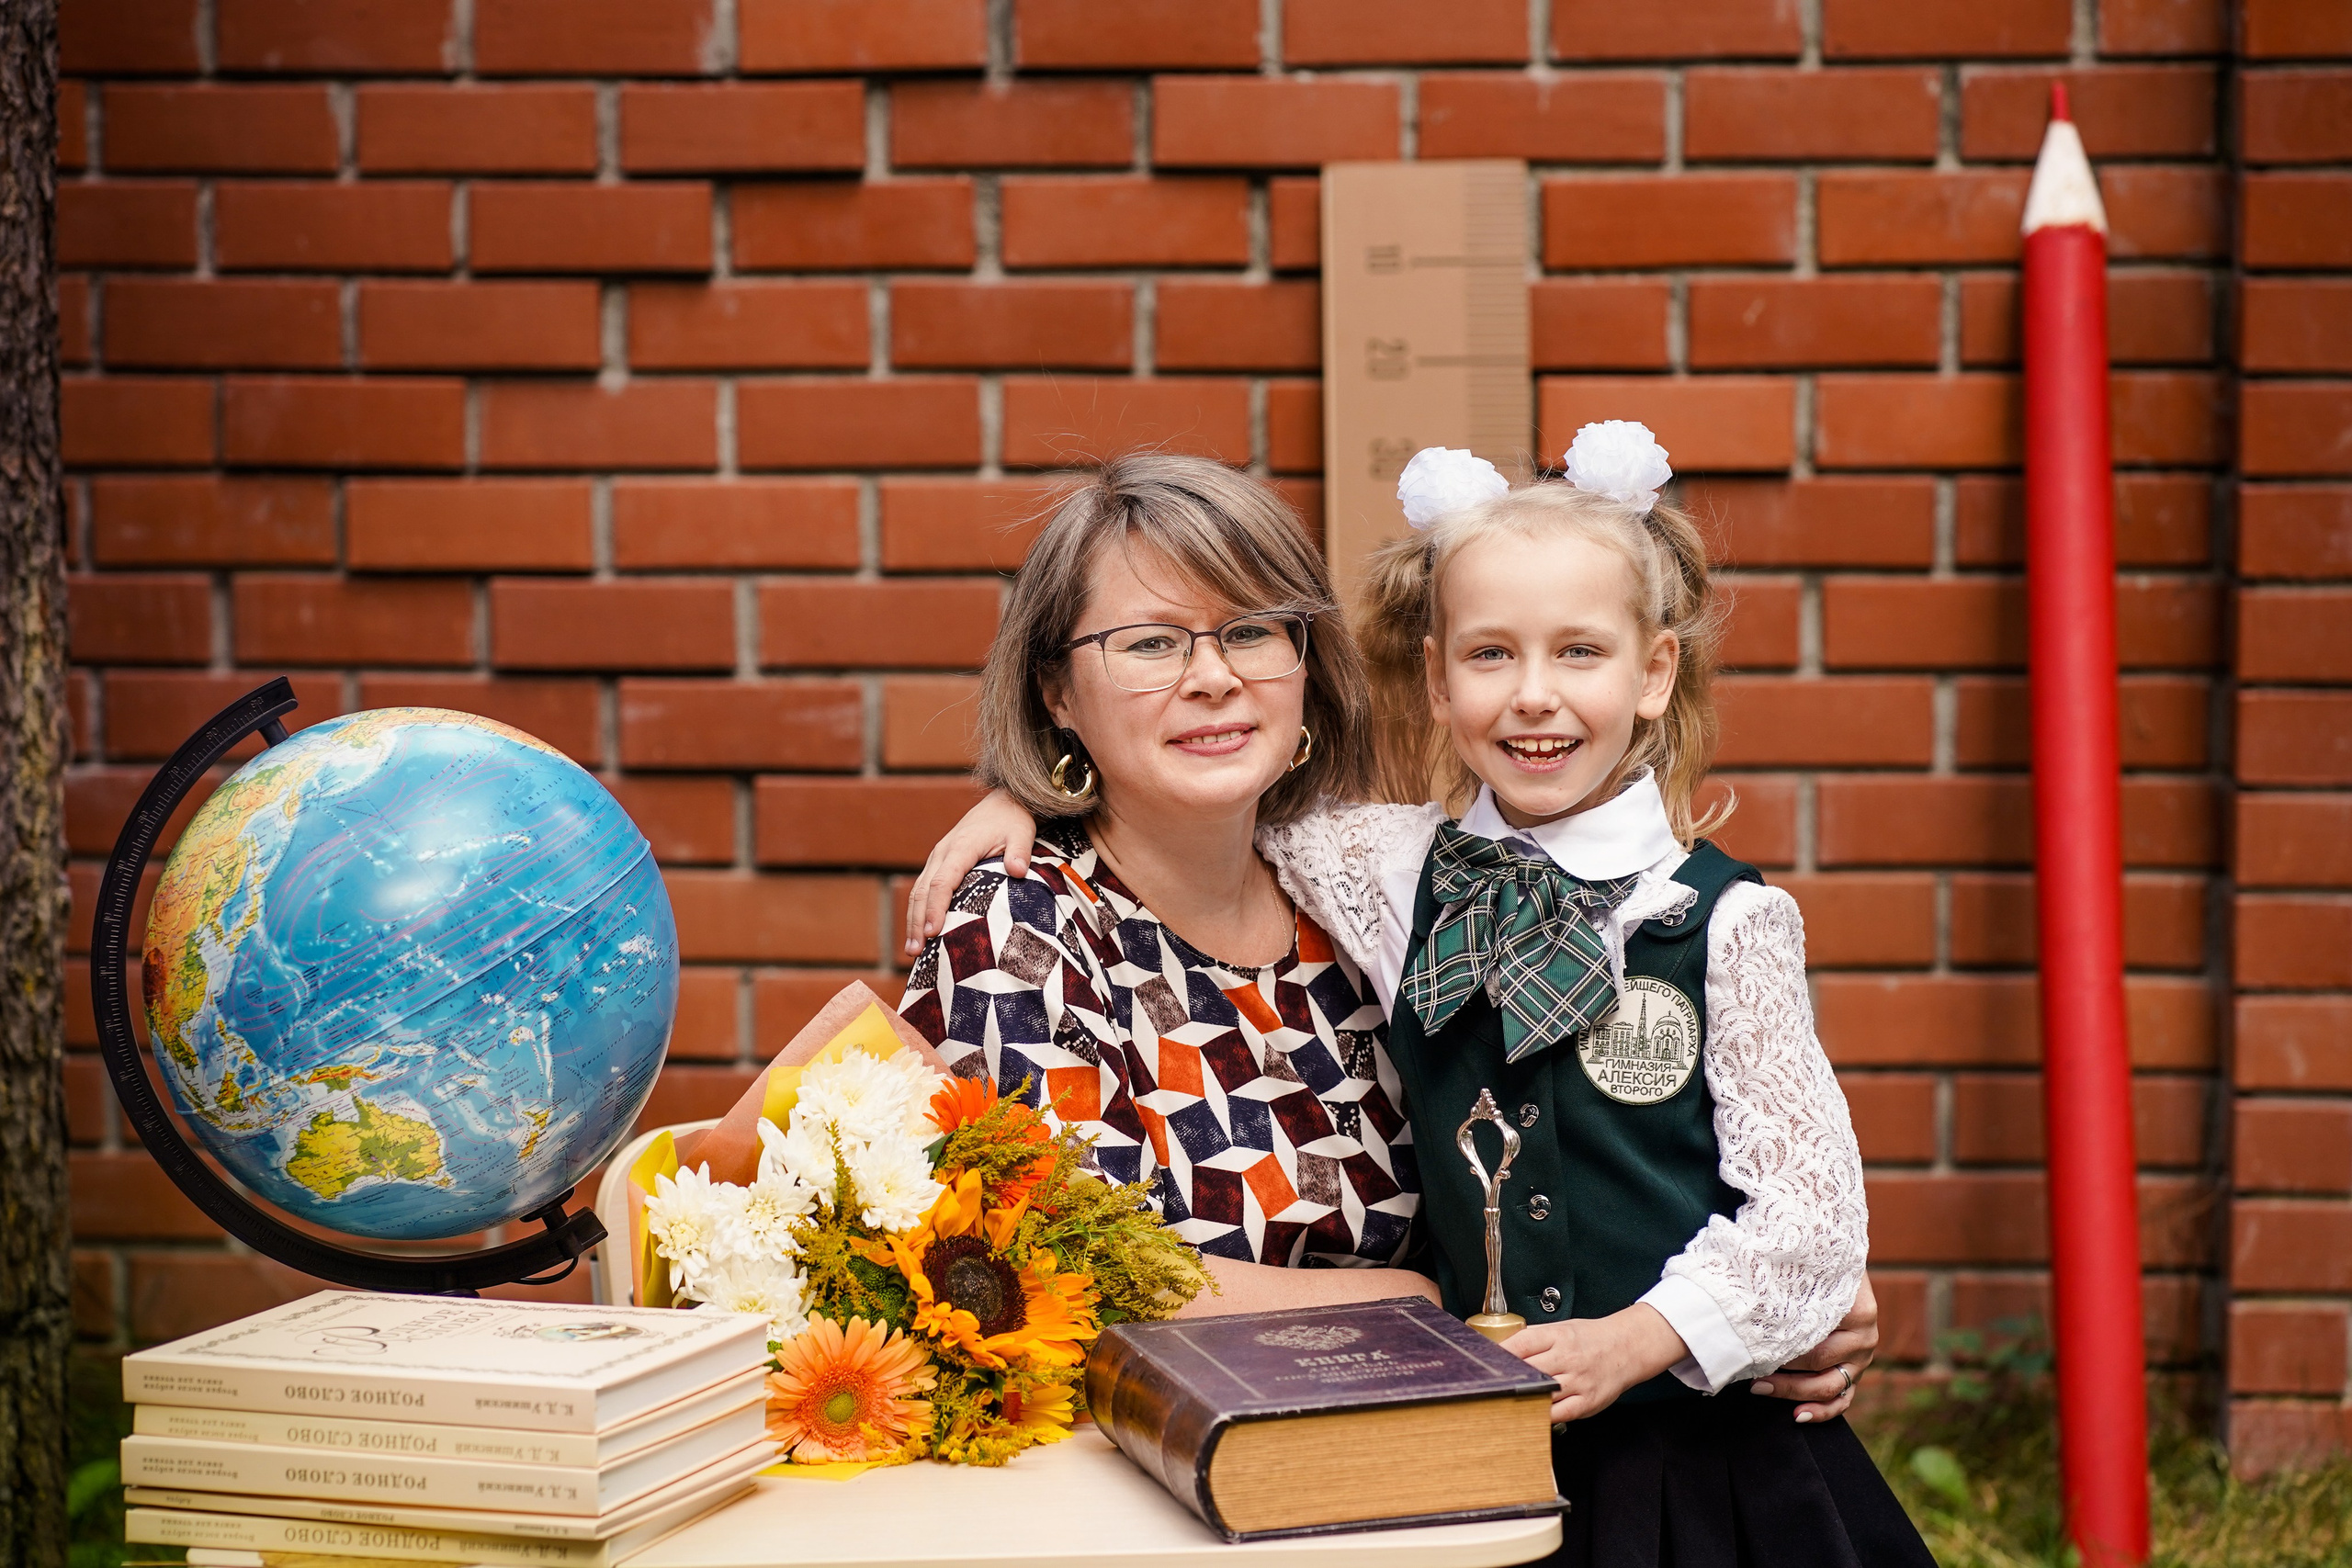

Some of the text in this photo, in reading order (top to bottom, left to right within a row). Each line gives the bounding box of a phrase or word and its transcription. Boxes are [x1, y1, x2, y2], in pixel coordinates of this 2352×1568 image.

[1367, 337, 1410, 381] 20
[1623, 978, 1672, 998] ЕЙШЕГО
[1671, 994, 1697, 1057] ПАТРИАРХА
[1605, 1058, 1672, 1073] ГИМНАЗИЯ
[1597, 1070, 1677, 1088] АЛЕКСИЯ
[1610, 1084, 1664, 1097] ВТОРОГО
[285, 1385, 425, 1407] РОДНОЕ СЛОВО
[475, 1398, 573, 1416] К. Д. Ушинский
[287, 1427, 437, 1452] РОДНОЕ СЛОВО
[455, 1442, 560, 1462] К. Д. Ушинский
[286, 1468, 427, 1490] РОДНОЕ СЛОВО
[478, 1481, 577, 1499] К. Д. Ушинский
[356, 1513, 395, 1522] РОДНОЕ
[285, 1527, 440, 1551] РОДНОЕ СЛОВО
[459, 1539, 568, 1560] К. Д. Ушинский
